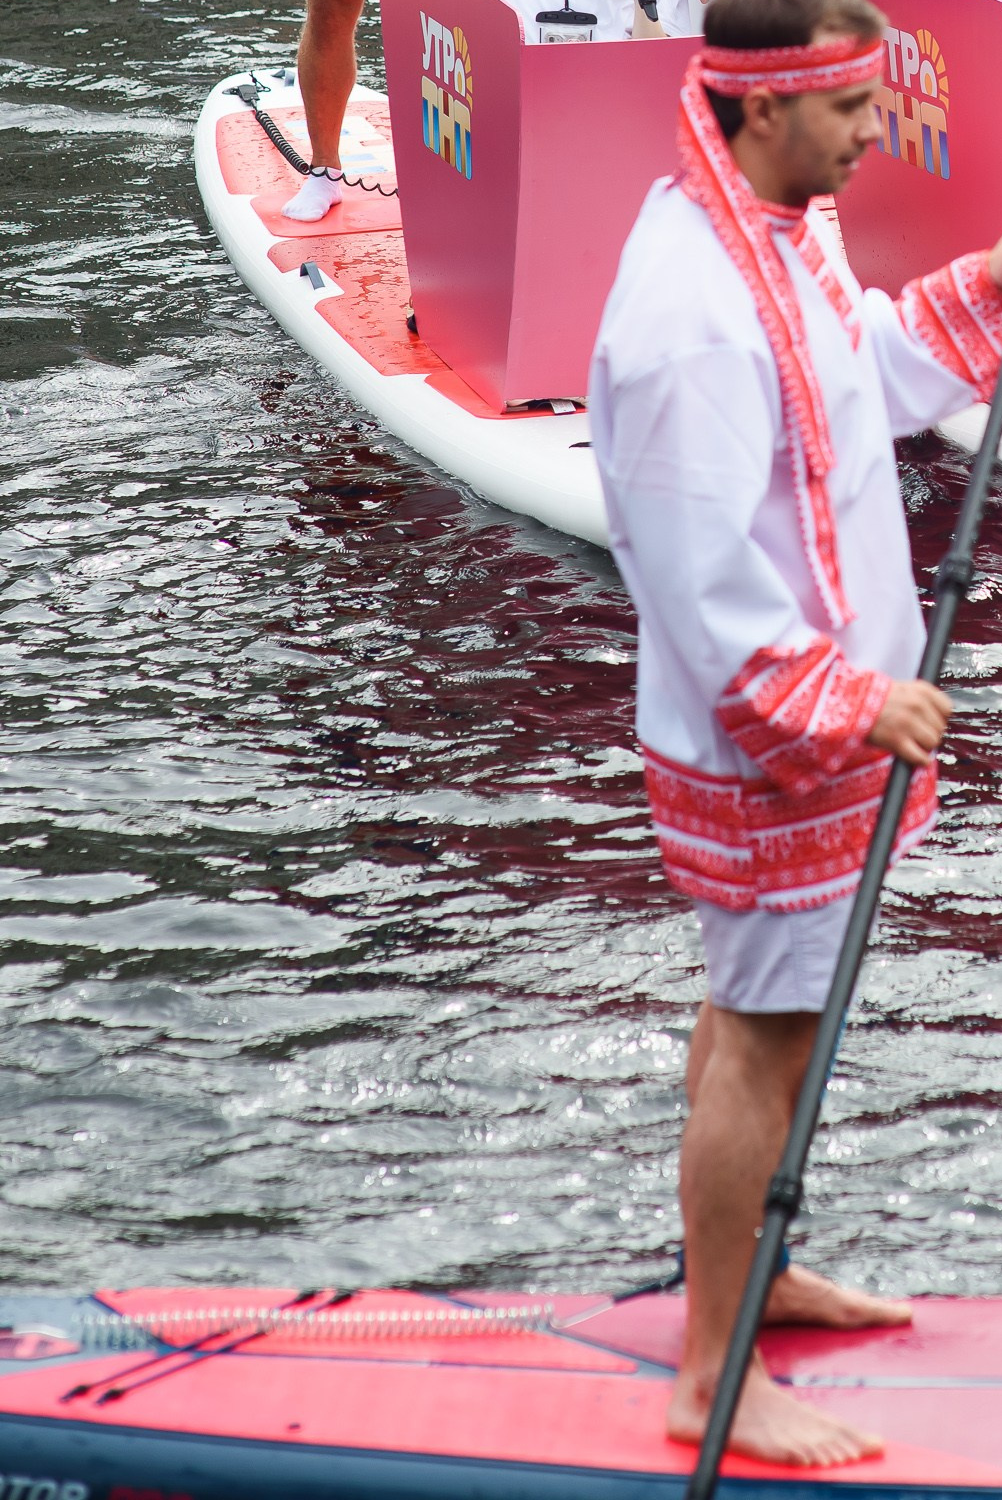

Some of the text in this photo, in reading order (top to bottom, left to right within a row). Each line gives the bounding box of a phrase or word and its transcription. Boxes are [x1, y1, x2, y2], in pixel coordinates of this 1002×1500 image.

[419, 10, 466, 98] УТРО
[883, 26, 938, 98] ТРО
[421, 75, 473, 181] ТНТ
[874, 85, 950, 180] ТНТ
